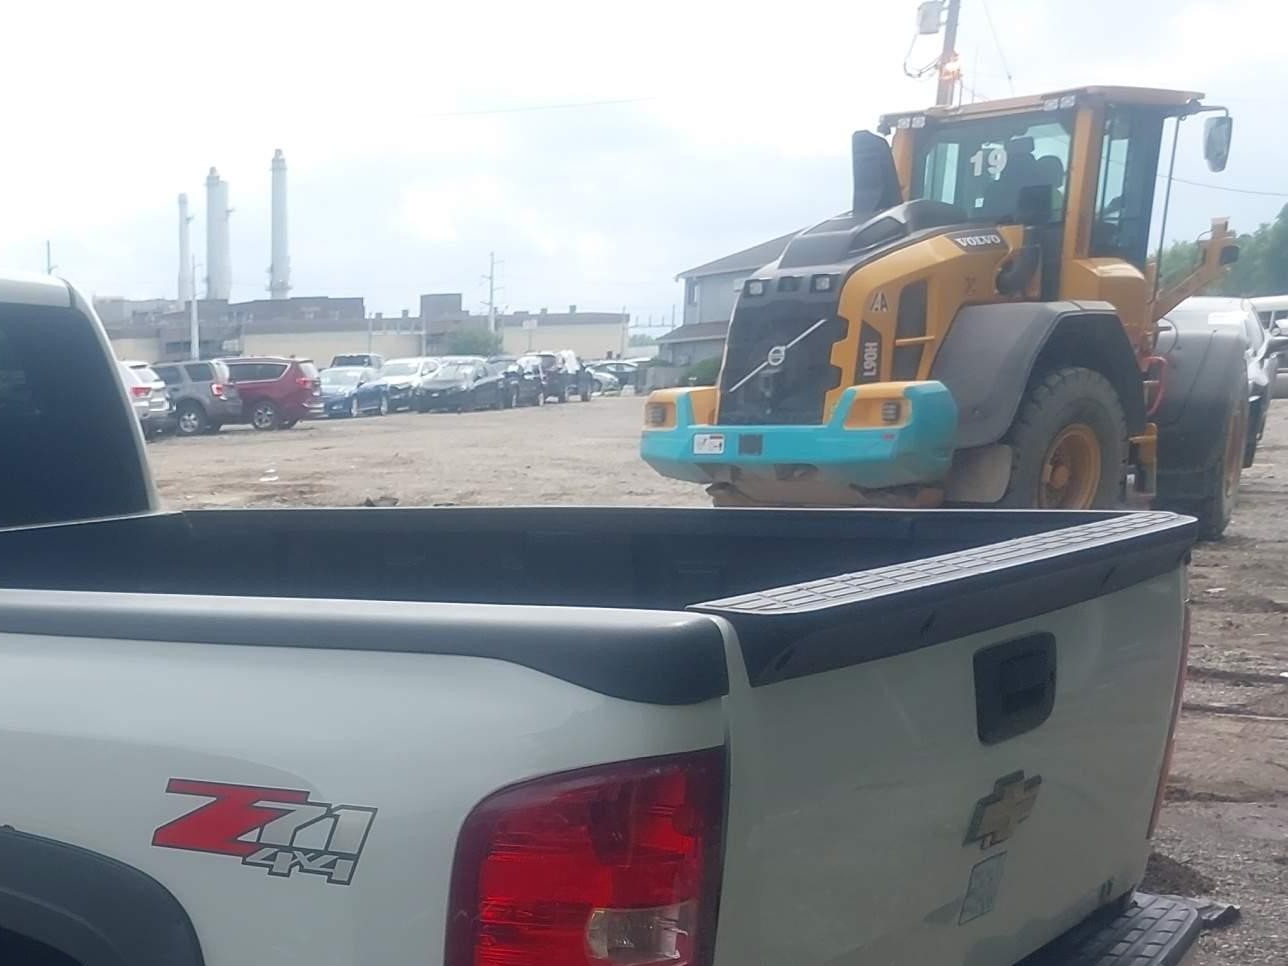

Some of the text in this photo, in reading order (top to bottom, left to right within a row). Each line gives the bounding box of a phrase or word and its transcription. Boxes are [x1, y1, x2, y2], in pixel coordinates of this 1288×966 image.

[970, 148, 1007, 176] 19
[954, 234, 1001, 247] VOLVO
[863, 341, 878, 376] L90H
[152, 777, 379, 857] Z71
